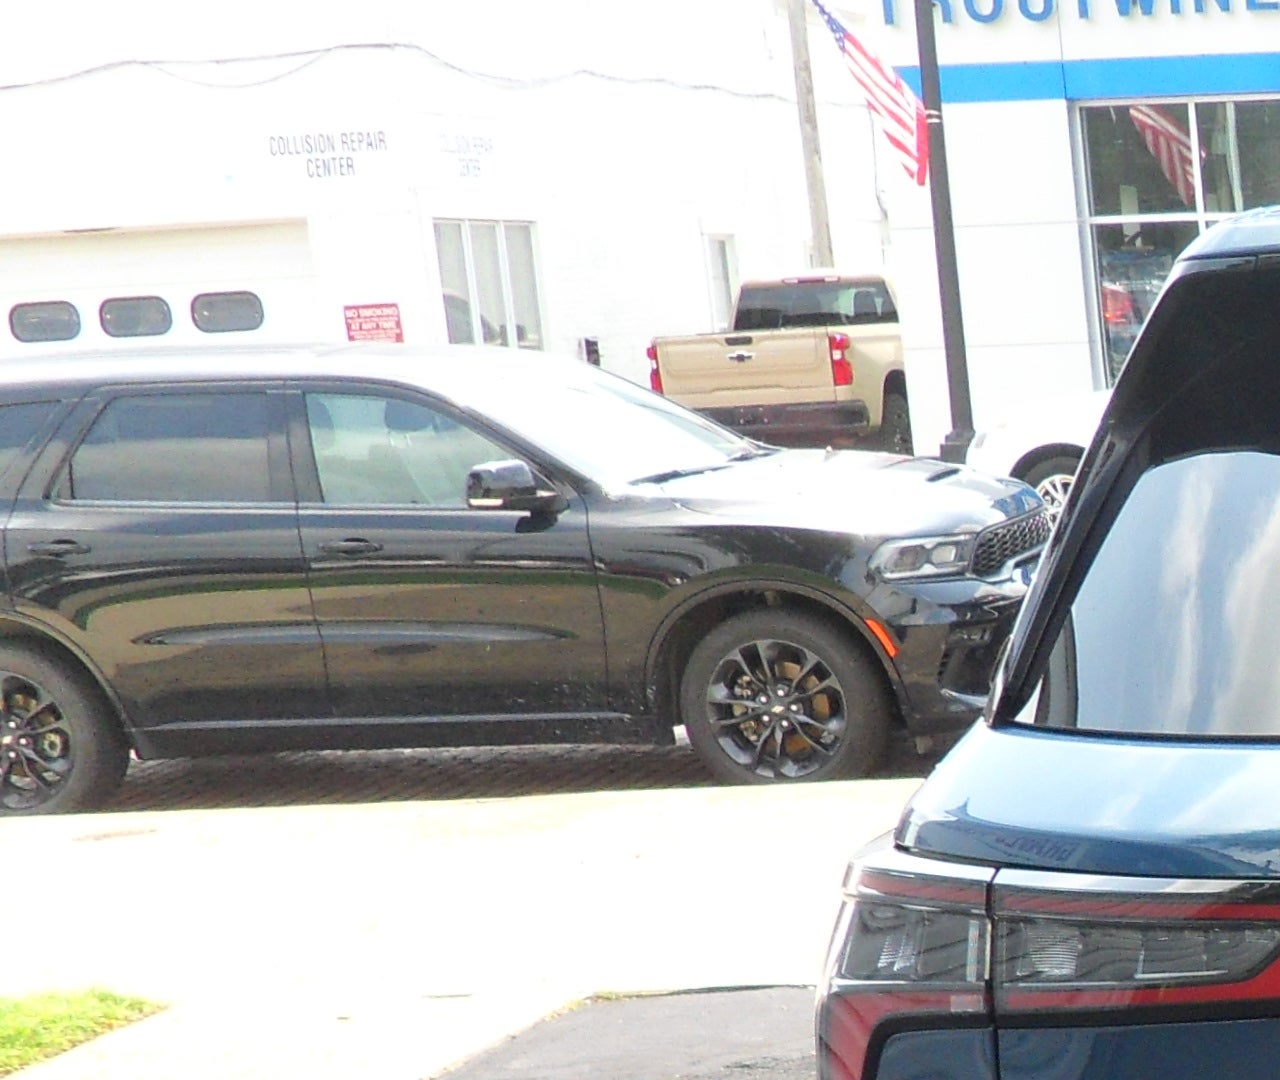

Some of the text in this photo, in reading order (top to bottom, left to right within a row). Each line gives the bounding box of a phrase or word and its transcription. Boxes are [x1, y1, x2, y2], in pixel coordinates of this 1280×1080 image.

[269, 130, 388, 157] COLLISION REPAIR
[306, 156, 356, 179] CENTER
